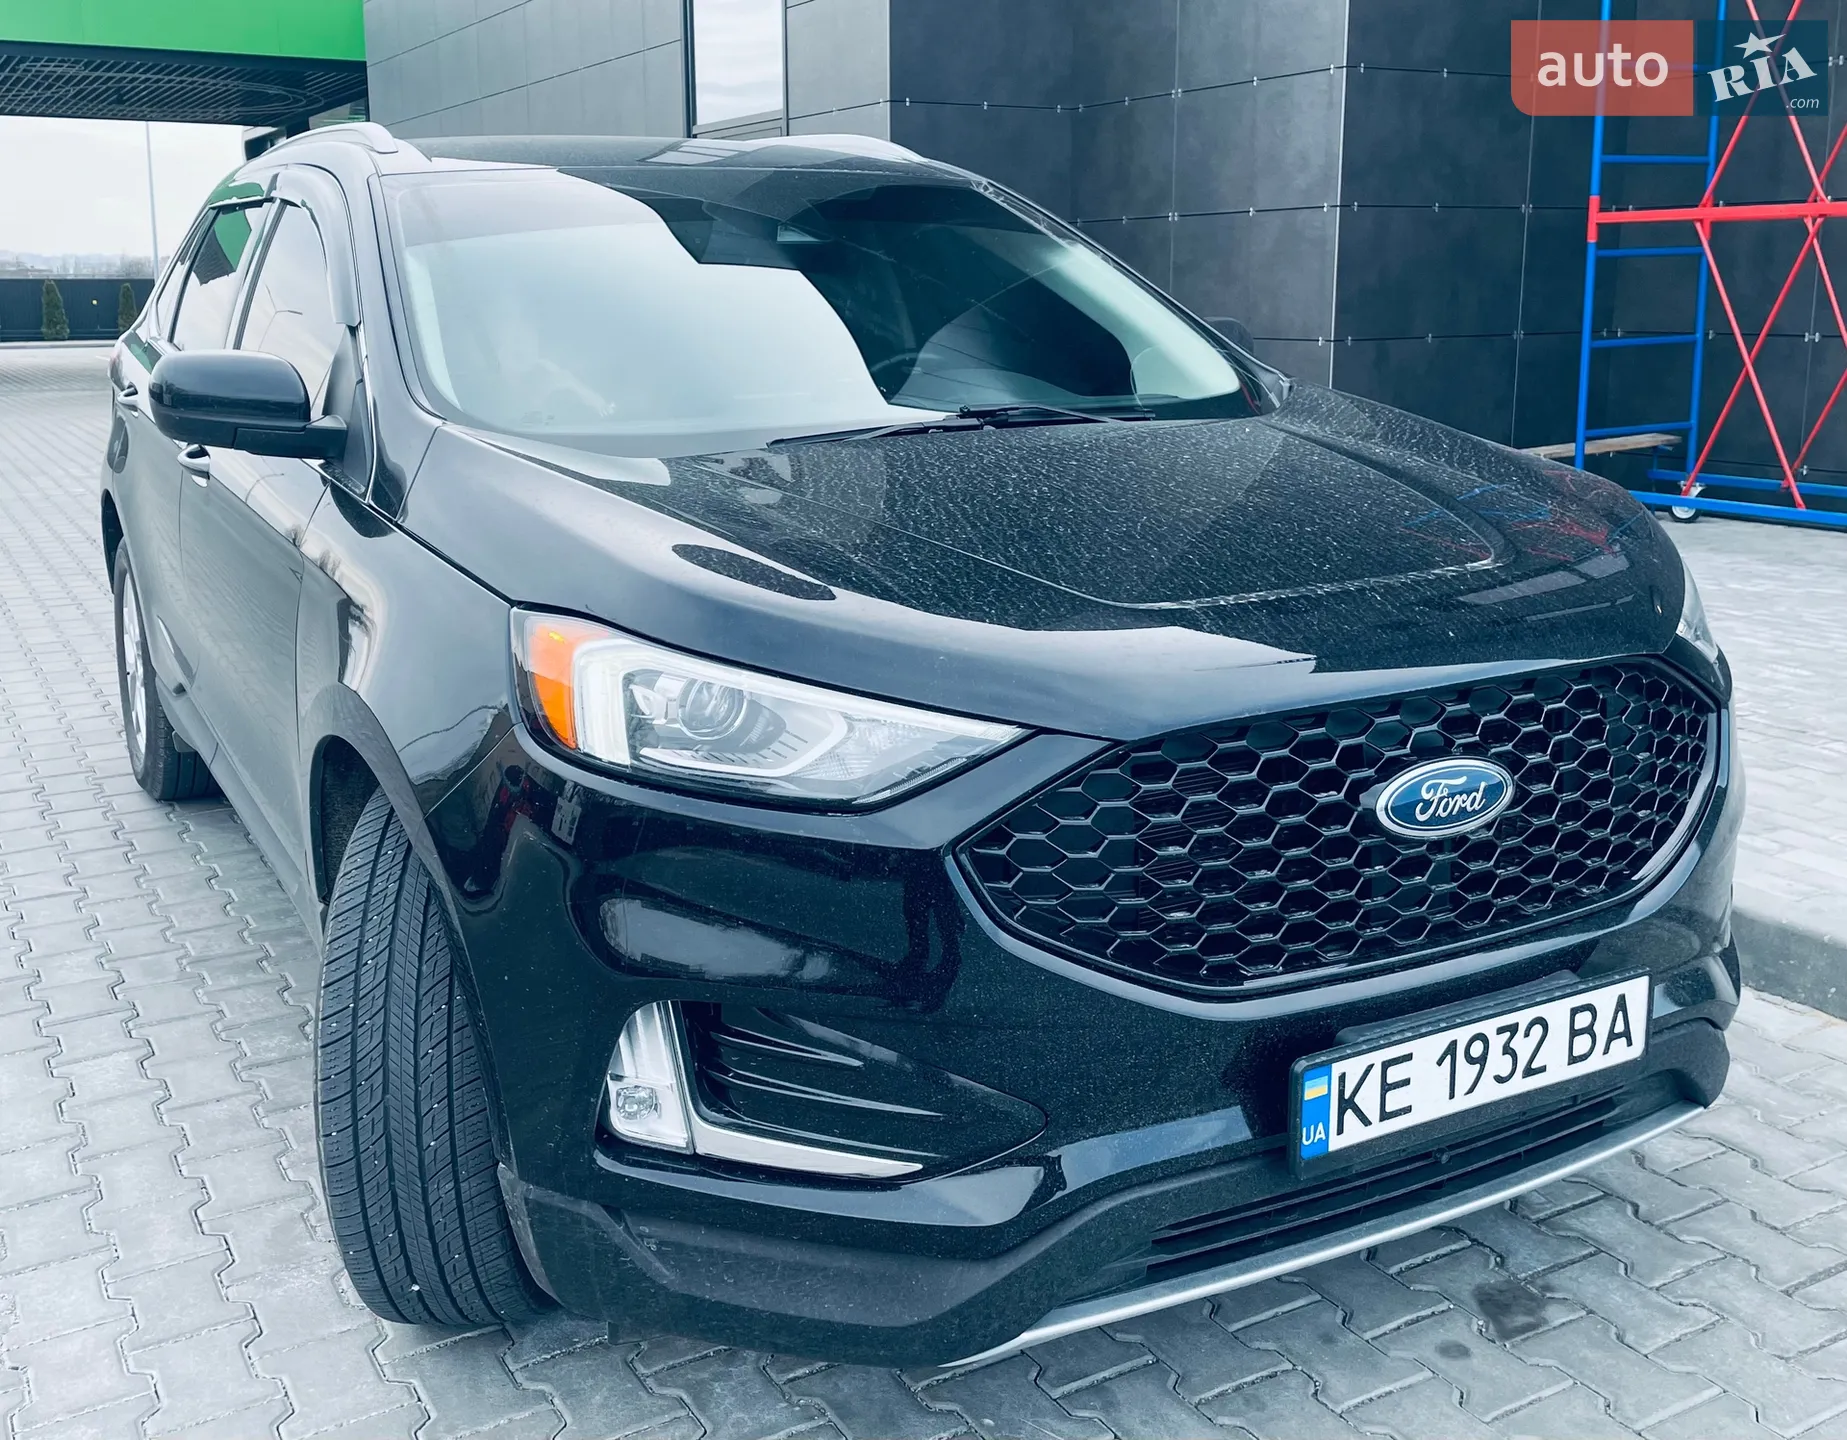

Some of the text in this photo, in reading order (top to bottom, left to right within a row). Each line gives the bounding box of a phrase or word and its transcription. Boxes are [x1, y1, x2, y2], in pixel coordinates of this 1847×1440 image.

[1415, 775, 1488, 822] Ford
[1336, 992, 1633, 1136] KE 1932 BA
[1302, 1125, 1326, 1146] UA
